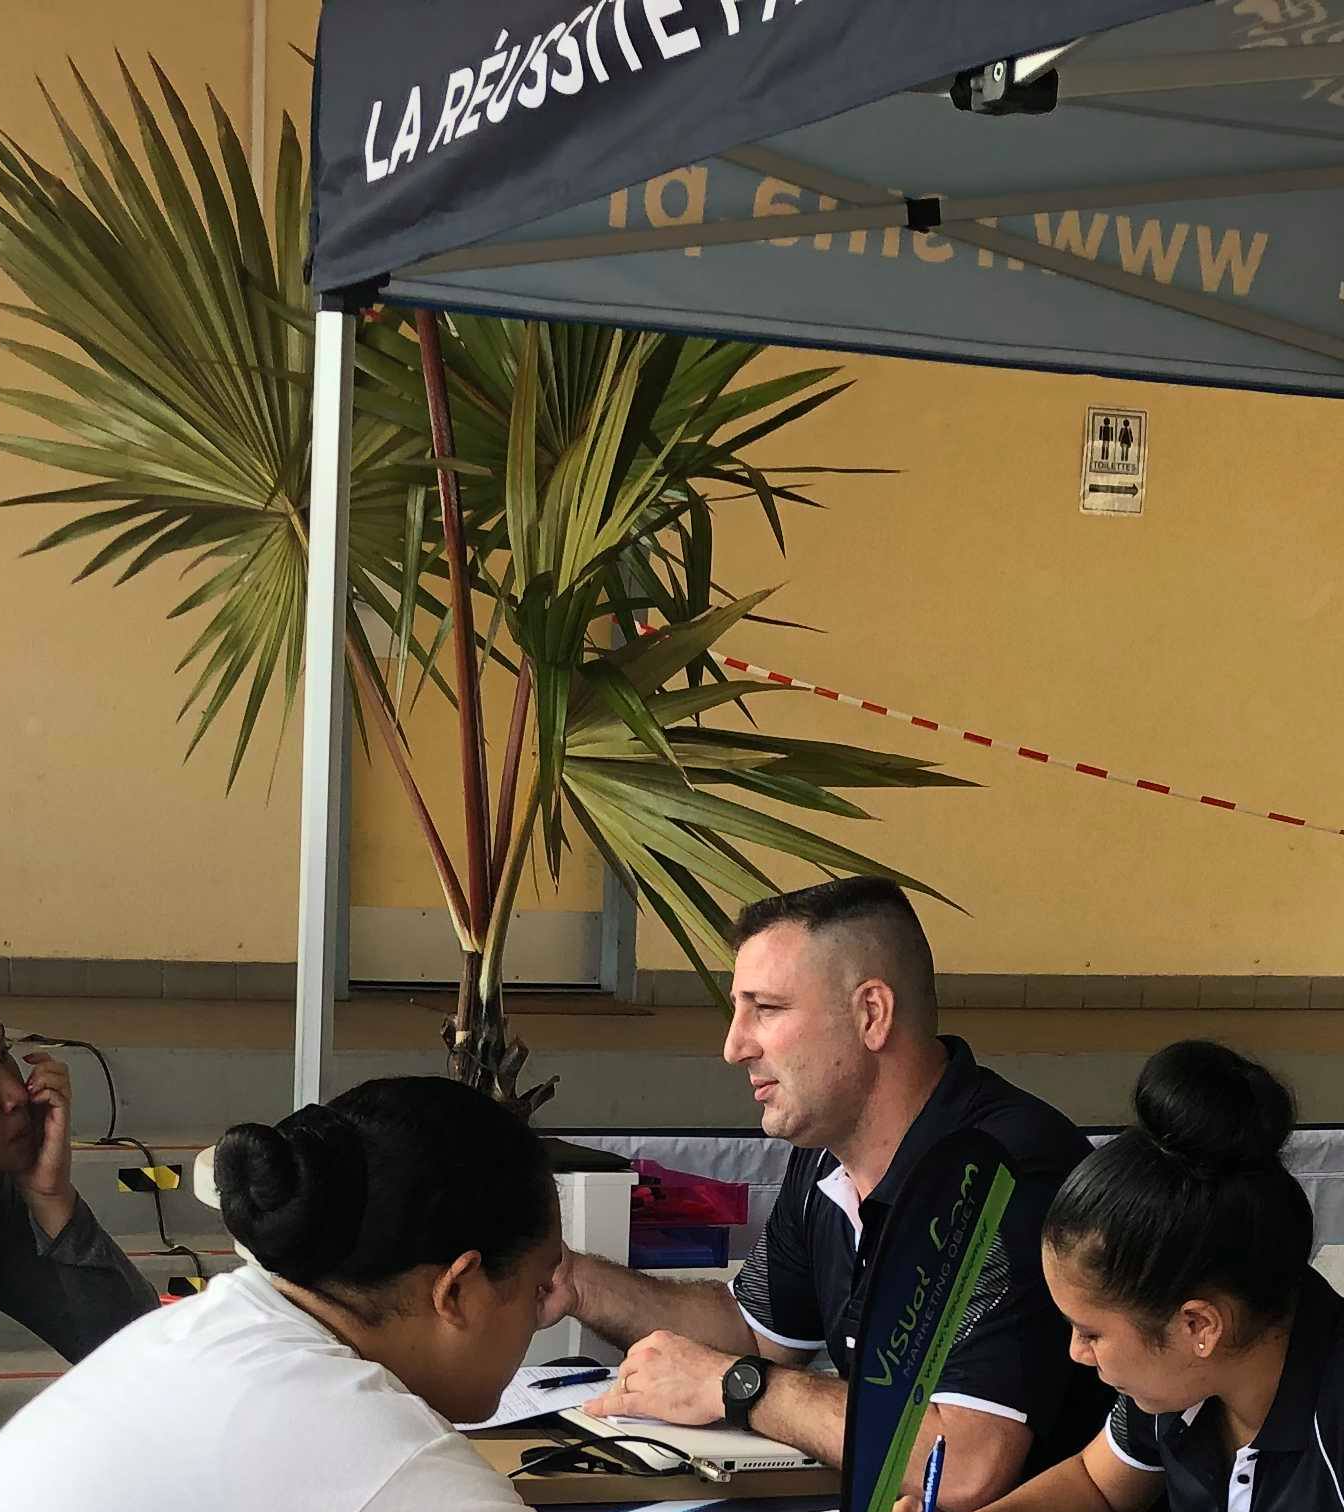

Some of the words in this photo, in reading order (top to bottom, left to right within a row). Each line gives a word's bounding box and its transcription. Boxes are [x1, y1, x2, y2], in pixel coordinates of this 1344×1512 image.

[364, 86, 422, 183] LA
[427, 0, 702, 153] RÉUSSITE
[1093, 460, 1137, 473] TOILETTES
[904, 1262, 952, 1377] MARKETING
[947, 1197, 977, 1259] OBJET
